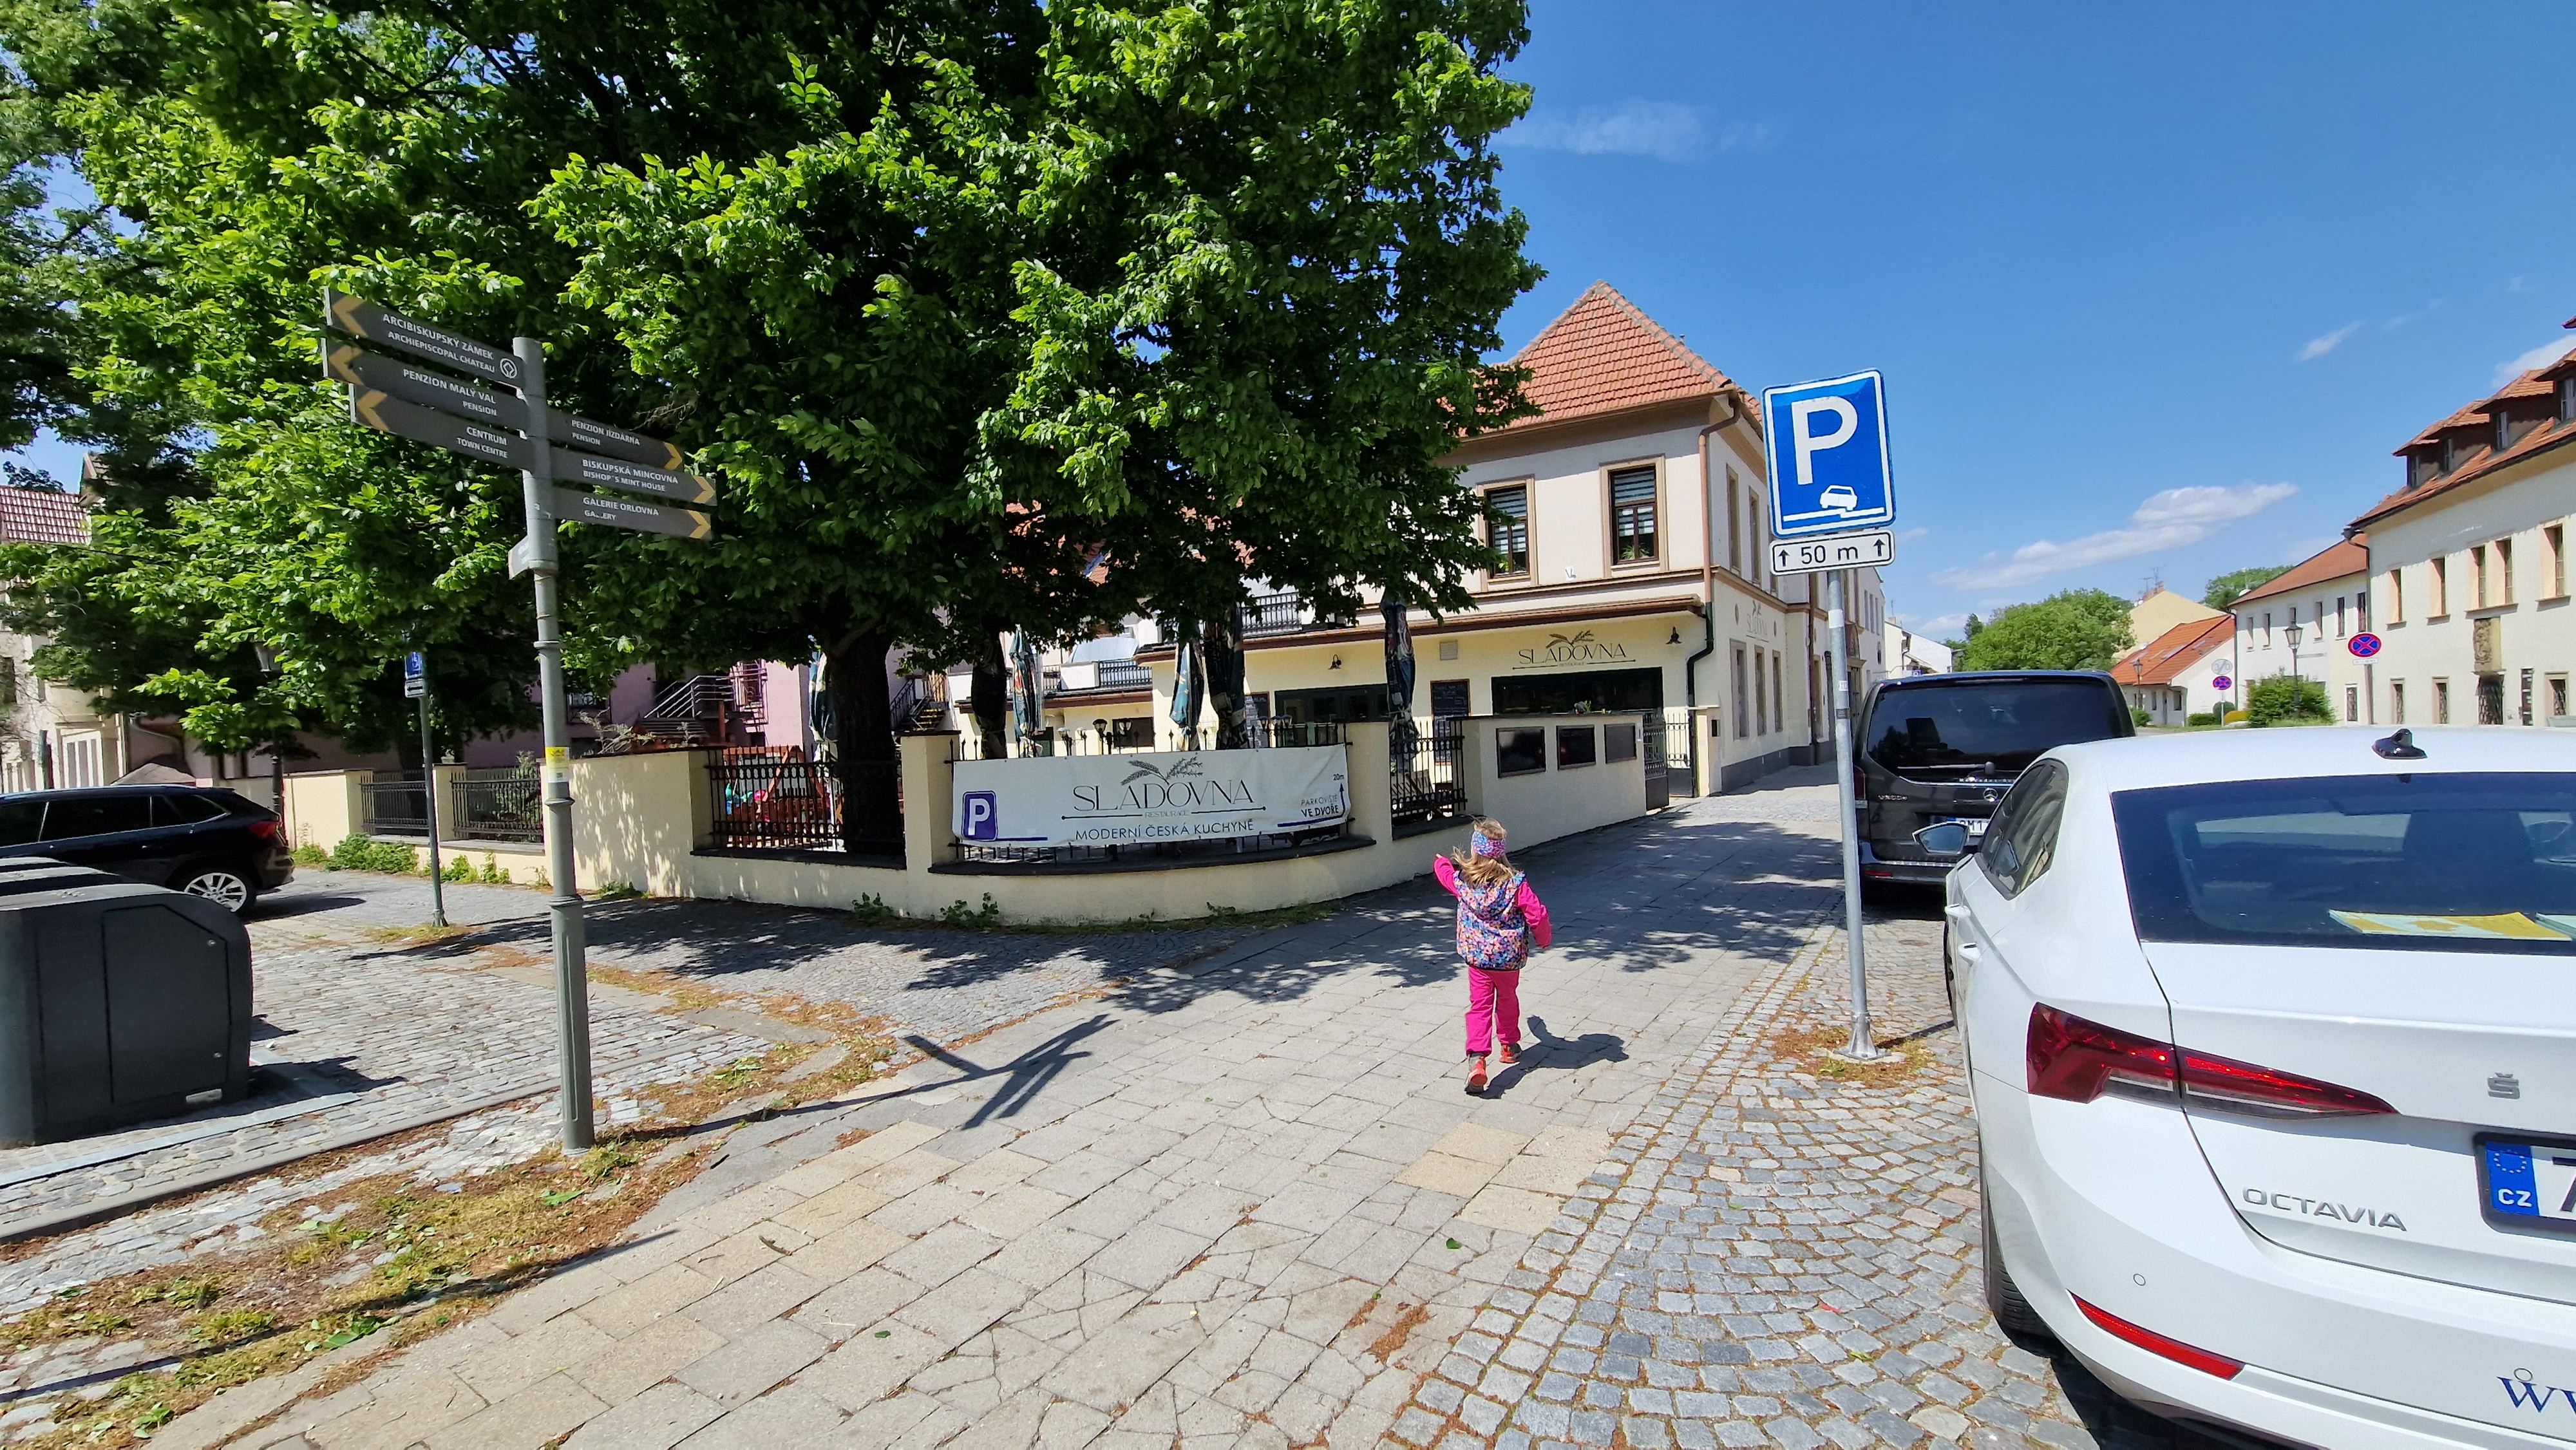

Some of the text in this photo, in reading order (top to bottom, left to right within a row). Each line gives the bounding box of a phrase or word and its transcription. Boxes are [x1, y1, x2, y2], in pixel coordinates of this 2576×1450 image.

[383, 314, 494, 360] ARCIBISKUPSKÝ ZÁMEK
[388, 331, 495, 373] ARCHIEPISCOPAL CHATEAU
[402, 369, 497, 404] PENZION MALÝ VAL
[462, 400, 497, 416] PENSION
[466, 426, 507, 446] CENTRUM
[571, 420, 604, 435] PENZION
[457, 437, 508, 458] TOWN CENTRE
[572, 432, 601, 446] PENSION
[1791, 396, 1858, 485] P
[582, 458, 678, 484] BISKUPSKÁ MINCOVNA
[621, 477, 640, 487] MINT
[641, 482, 666, 492] HOUSE
[583, 497, 659, 516] GALERIE ORLOVNA
[584, 510, 616, 520] GAERY
[1801, 545, 1859, 564] 50 m
[1519, 643, 1627, 664] SLADOVNA
[1073, 779, 1255, 811] SLADOVNA
[968, 798, 990, 836] P
[1144, 809, 1190, 818] RESTAURACE
[1301, 804, 1339, 817] VE DVOŘE
[1075, 818, 1254, 840] MODERNÍ ČESKÁ KUCHYNĚ
[2498, 1189, 2533, 1207] CZ
[2242, 1187, 2407, 1232] OCTAVIA
